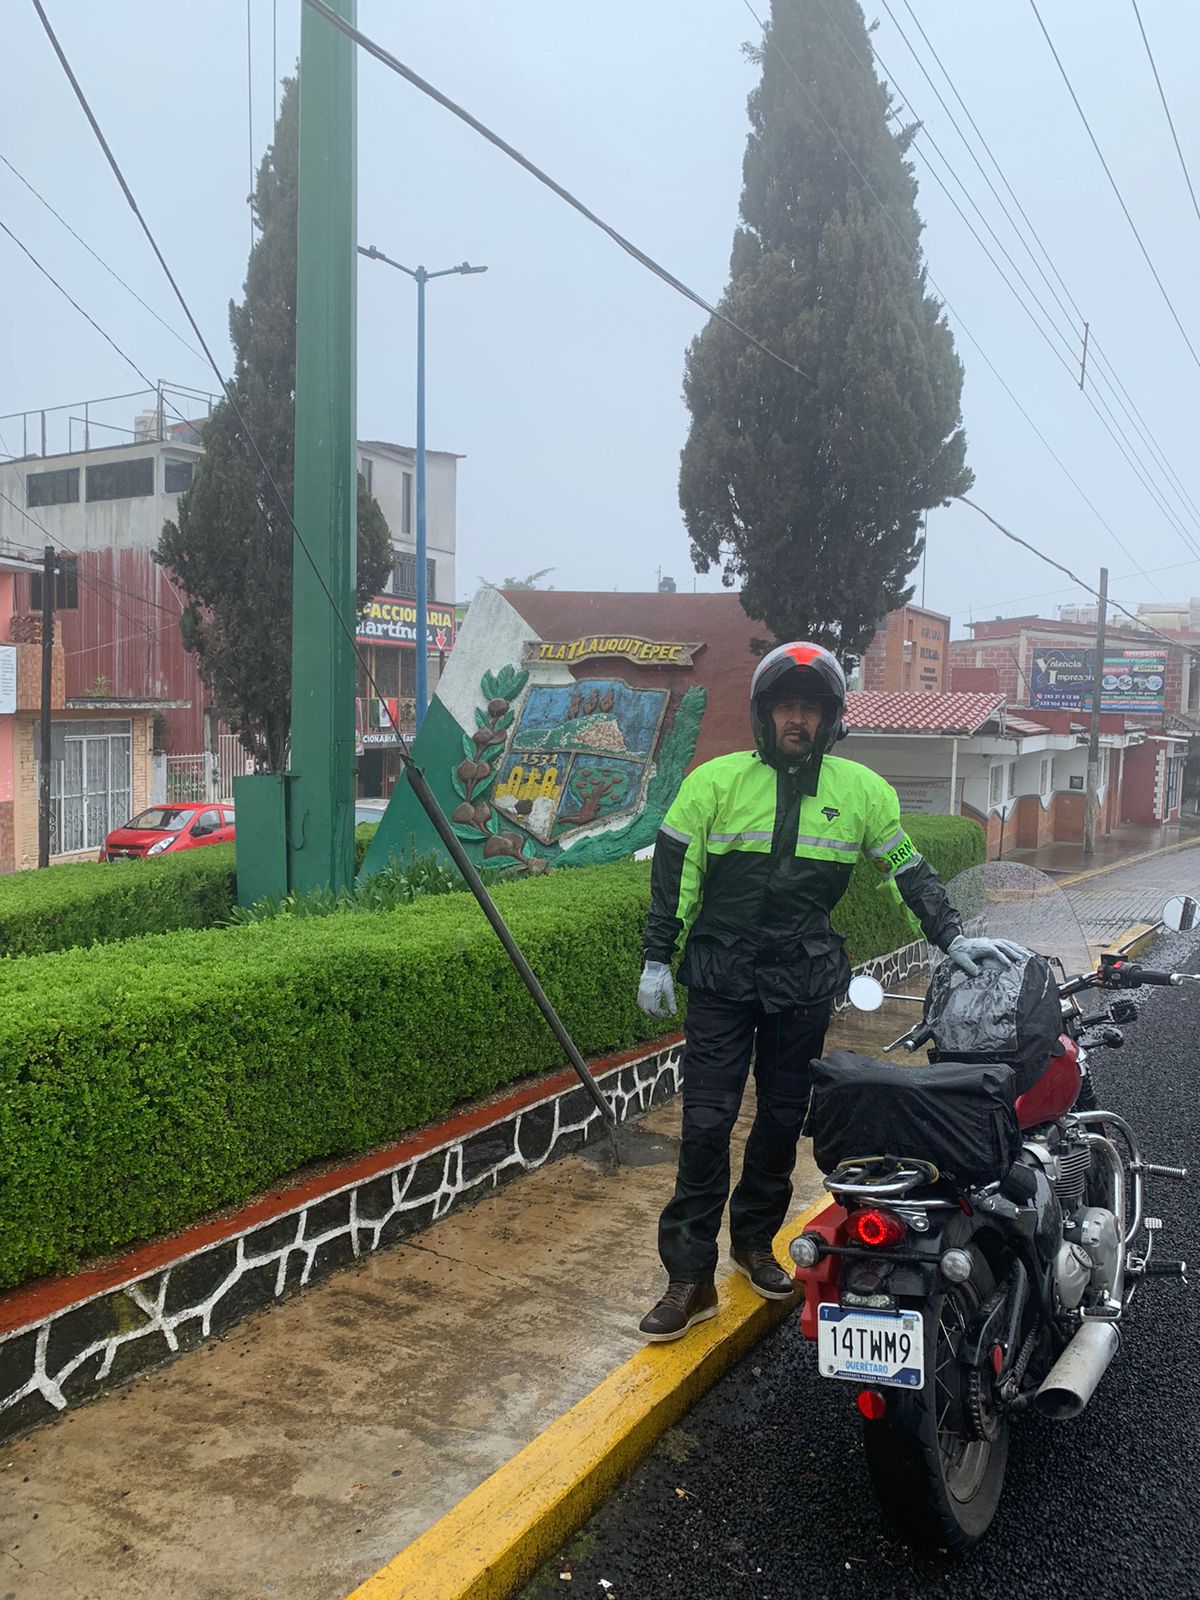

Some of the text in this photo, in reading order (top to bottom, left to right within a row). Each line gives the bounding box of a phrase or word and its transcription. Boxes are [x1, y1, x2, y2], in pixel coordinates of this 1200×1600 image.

[539, 638, 682, 661] TLATLAUQUITEPEC
[1036, 657, 1082, 673] Valencia
[521, 754, 559, 766] 1531
[823, 1309, 830, 1319] T
[831, 1326, 911, 1364] 14TWM9
[845, 1360, 889, 1374] QUERÉTARO
